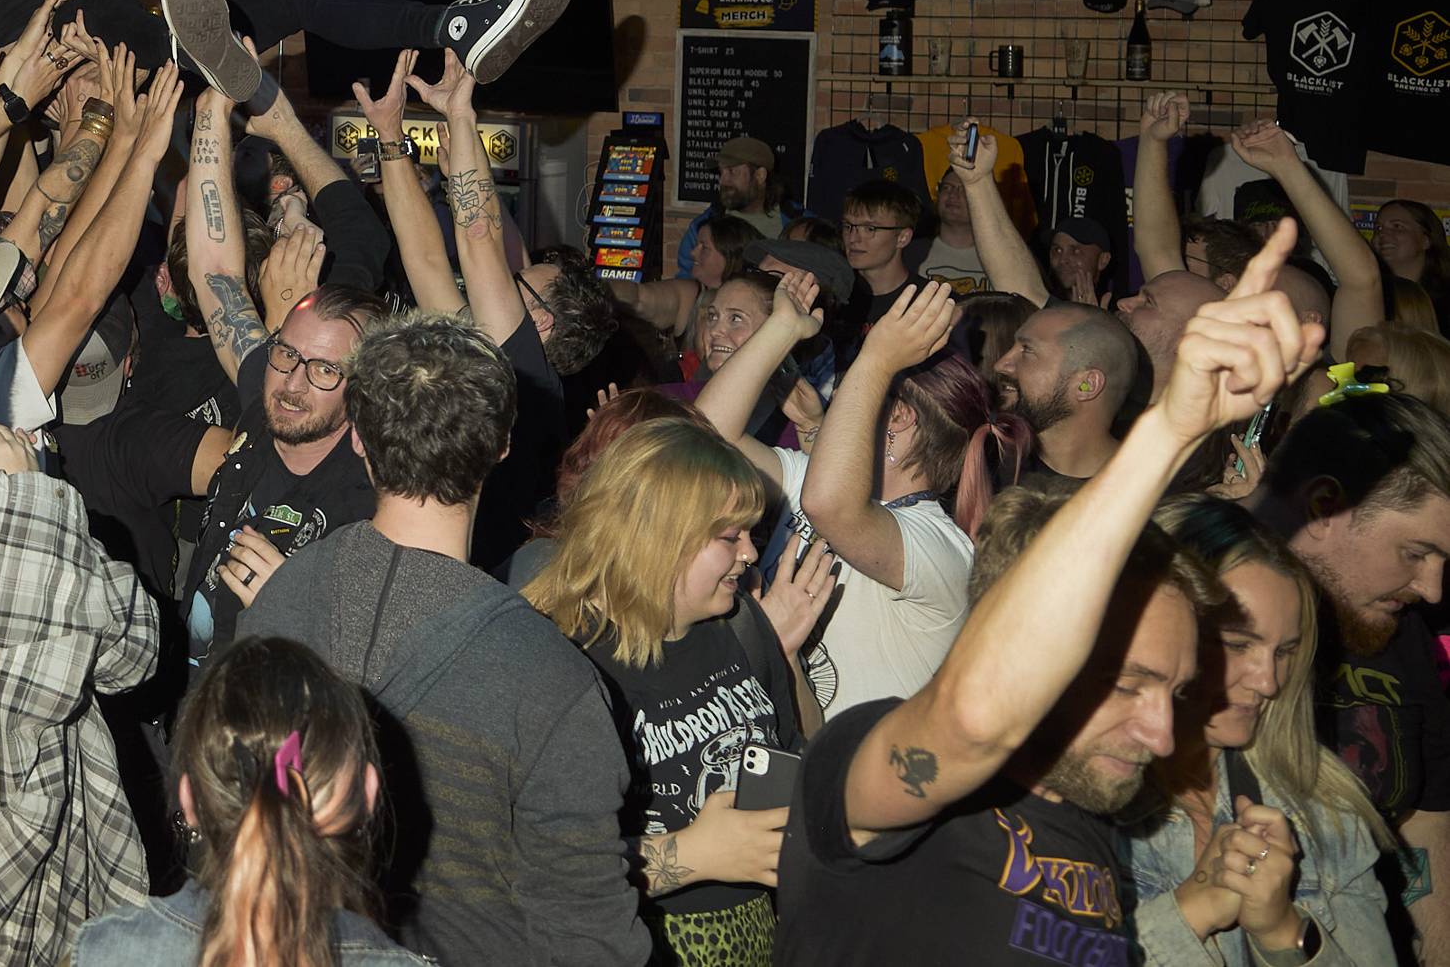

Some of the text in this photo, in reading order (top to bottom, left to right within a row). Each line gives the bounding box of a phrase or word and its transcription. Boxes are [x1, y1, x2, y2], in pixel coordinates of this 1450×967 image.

[721, 10, 766, 21] MERCH
[690, 46, 718, 54] T-SHIRT
[690, 67, 721, 76] SUPERIOR
[718, 78, 744, 88] HOODIE
[1286, 72, 1344, 90] BLACKLIST
[1387, 72, 1450, 89] BLACKLIST
[1294, 82, 1325, 92] BREWING
[1394, 83, 1428, 92] BREWING
[709, 89, 734, 98] HOODIE
[687, 120, 711, 128] WINTER
[716, 120, 729, 128] HAT
[718, 130, 732, 138] HAT
[686, 140, 726, 148] STAINLES
[686, 150, 718, 158] INSULAT
[686, 160, 706, 168] SHAK
[601, 268, 637, 280] GAME!
